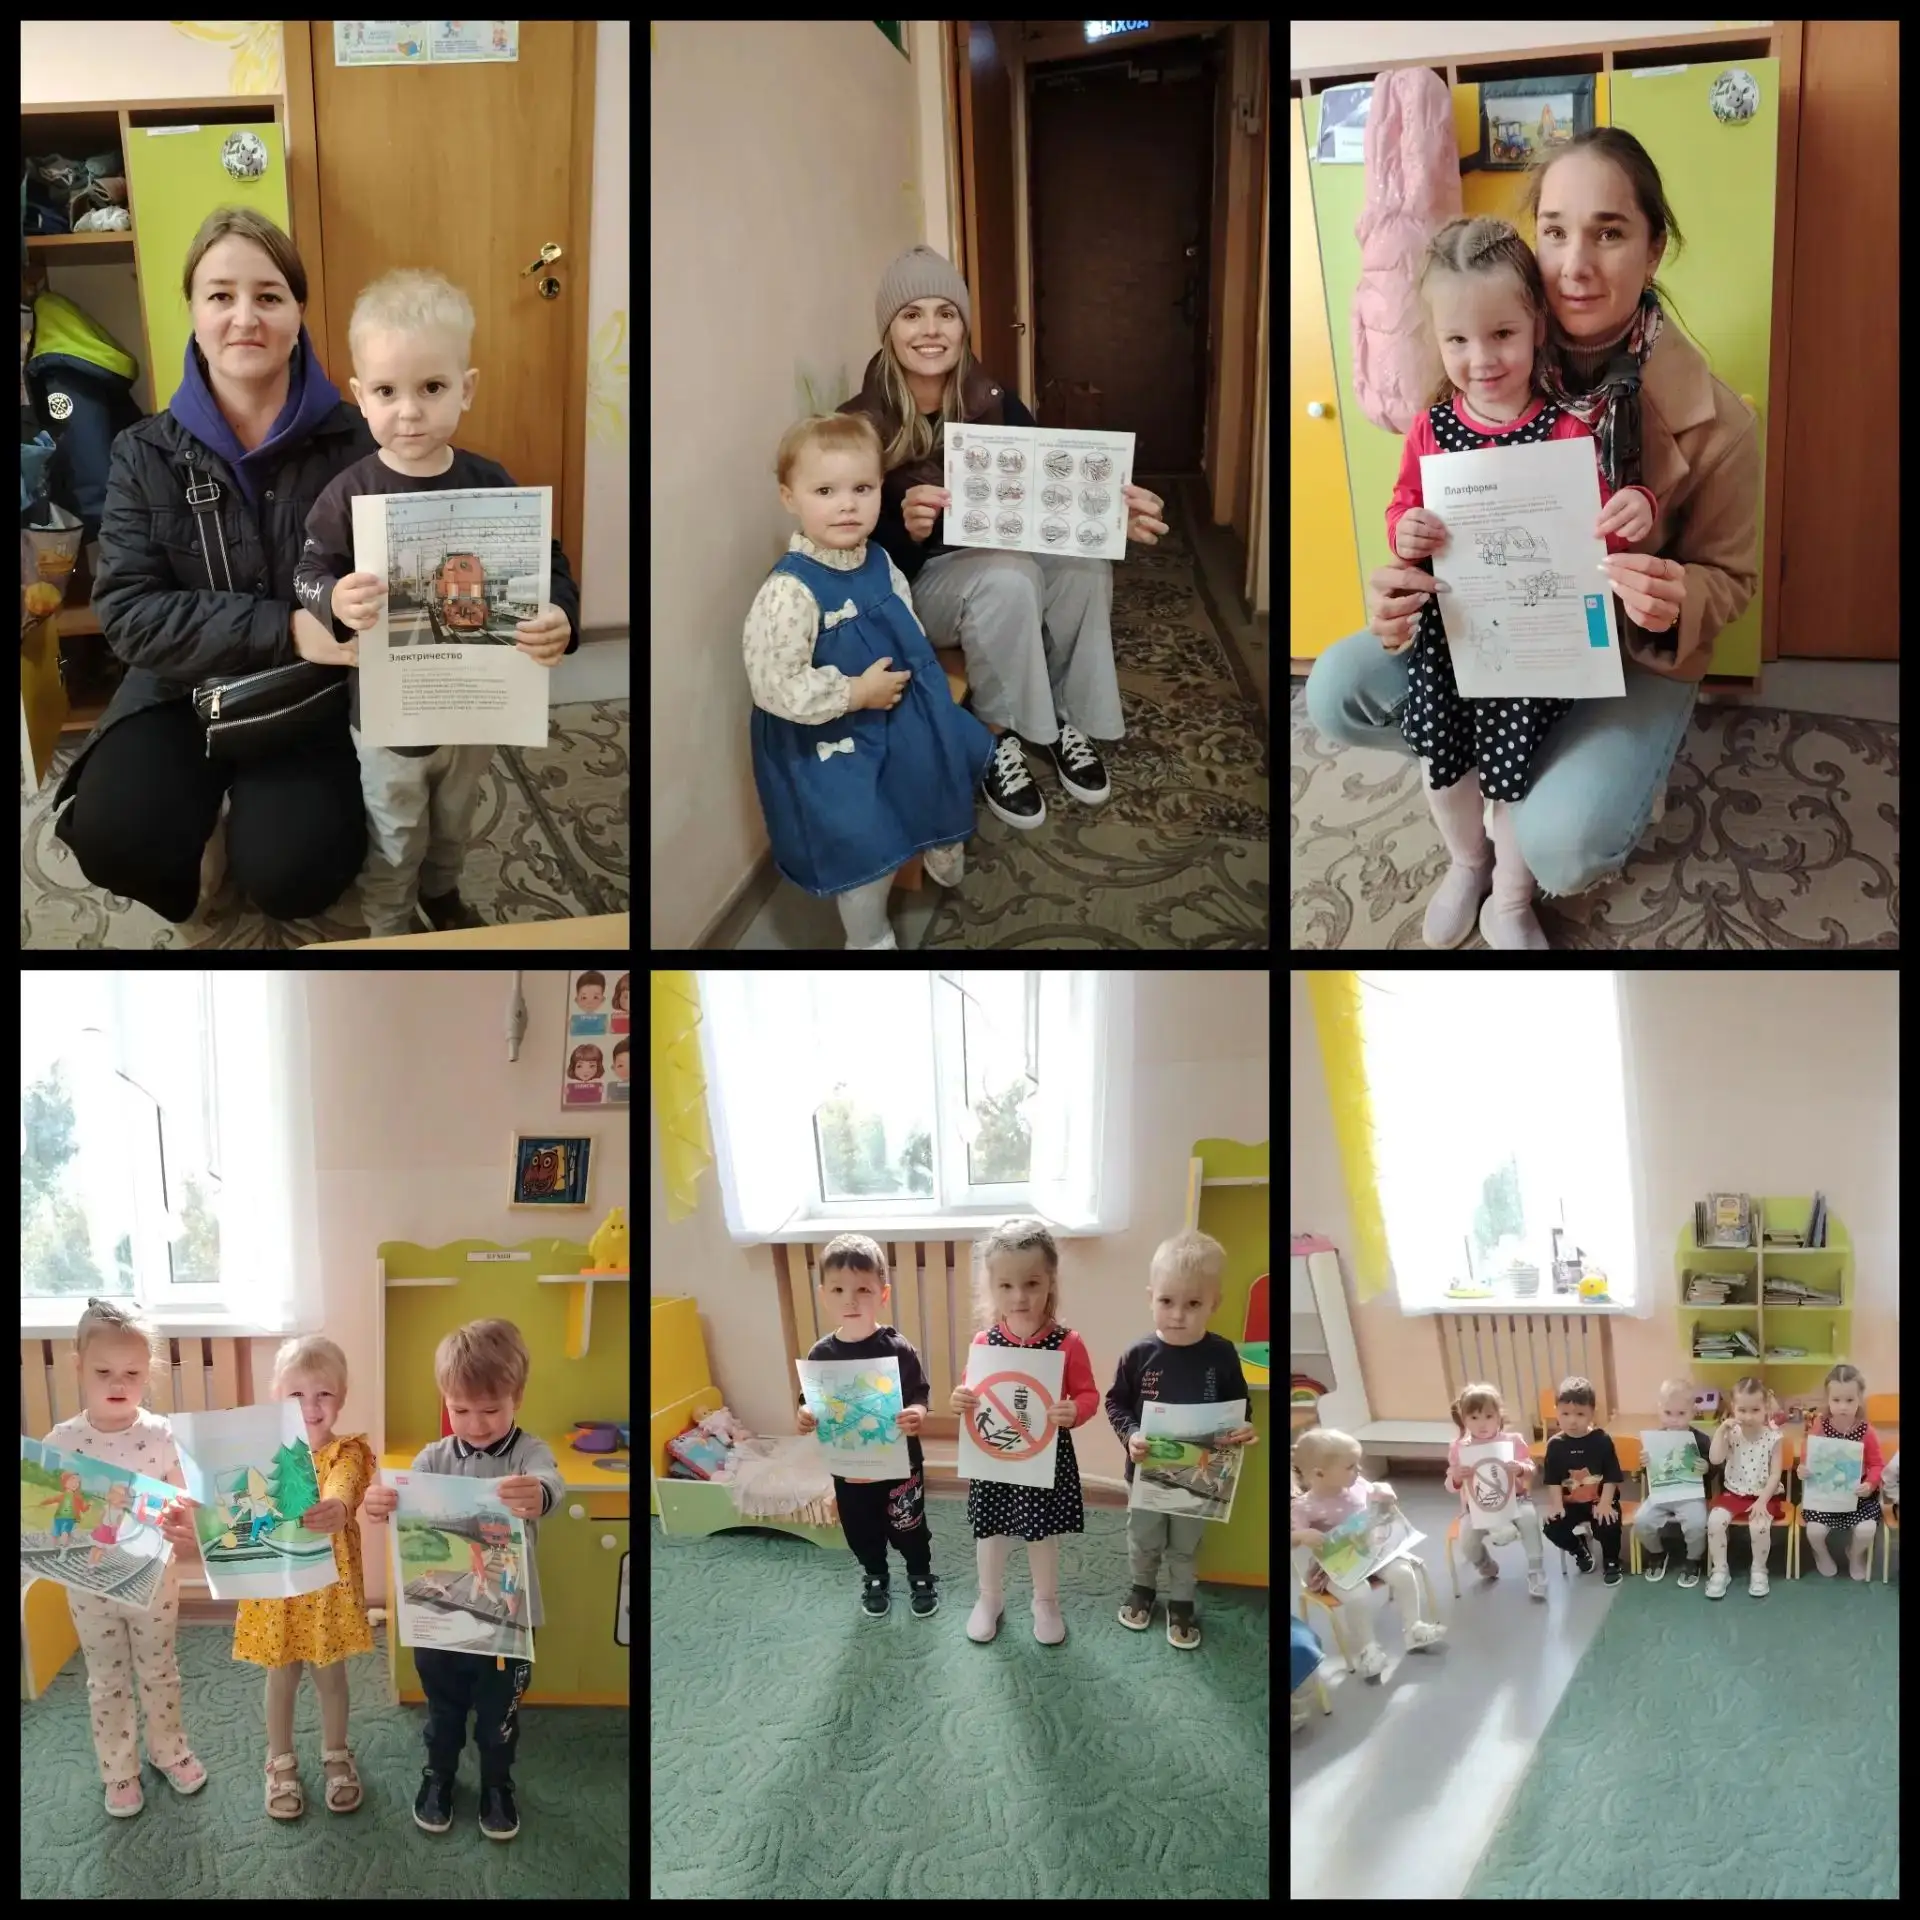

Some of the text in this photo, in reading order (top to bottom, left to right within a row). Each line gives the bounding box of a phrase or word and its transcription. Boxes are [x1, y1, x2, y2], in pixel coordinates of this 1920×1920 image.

[1087, 21, 1149, 37] ЫХОД
[1444, 483, 1498, 496] Платформа
[388, 652, 463, 662] Электричество
